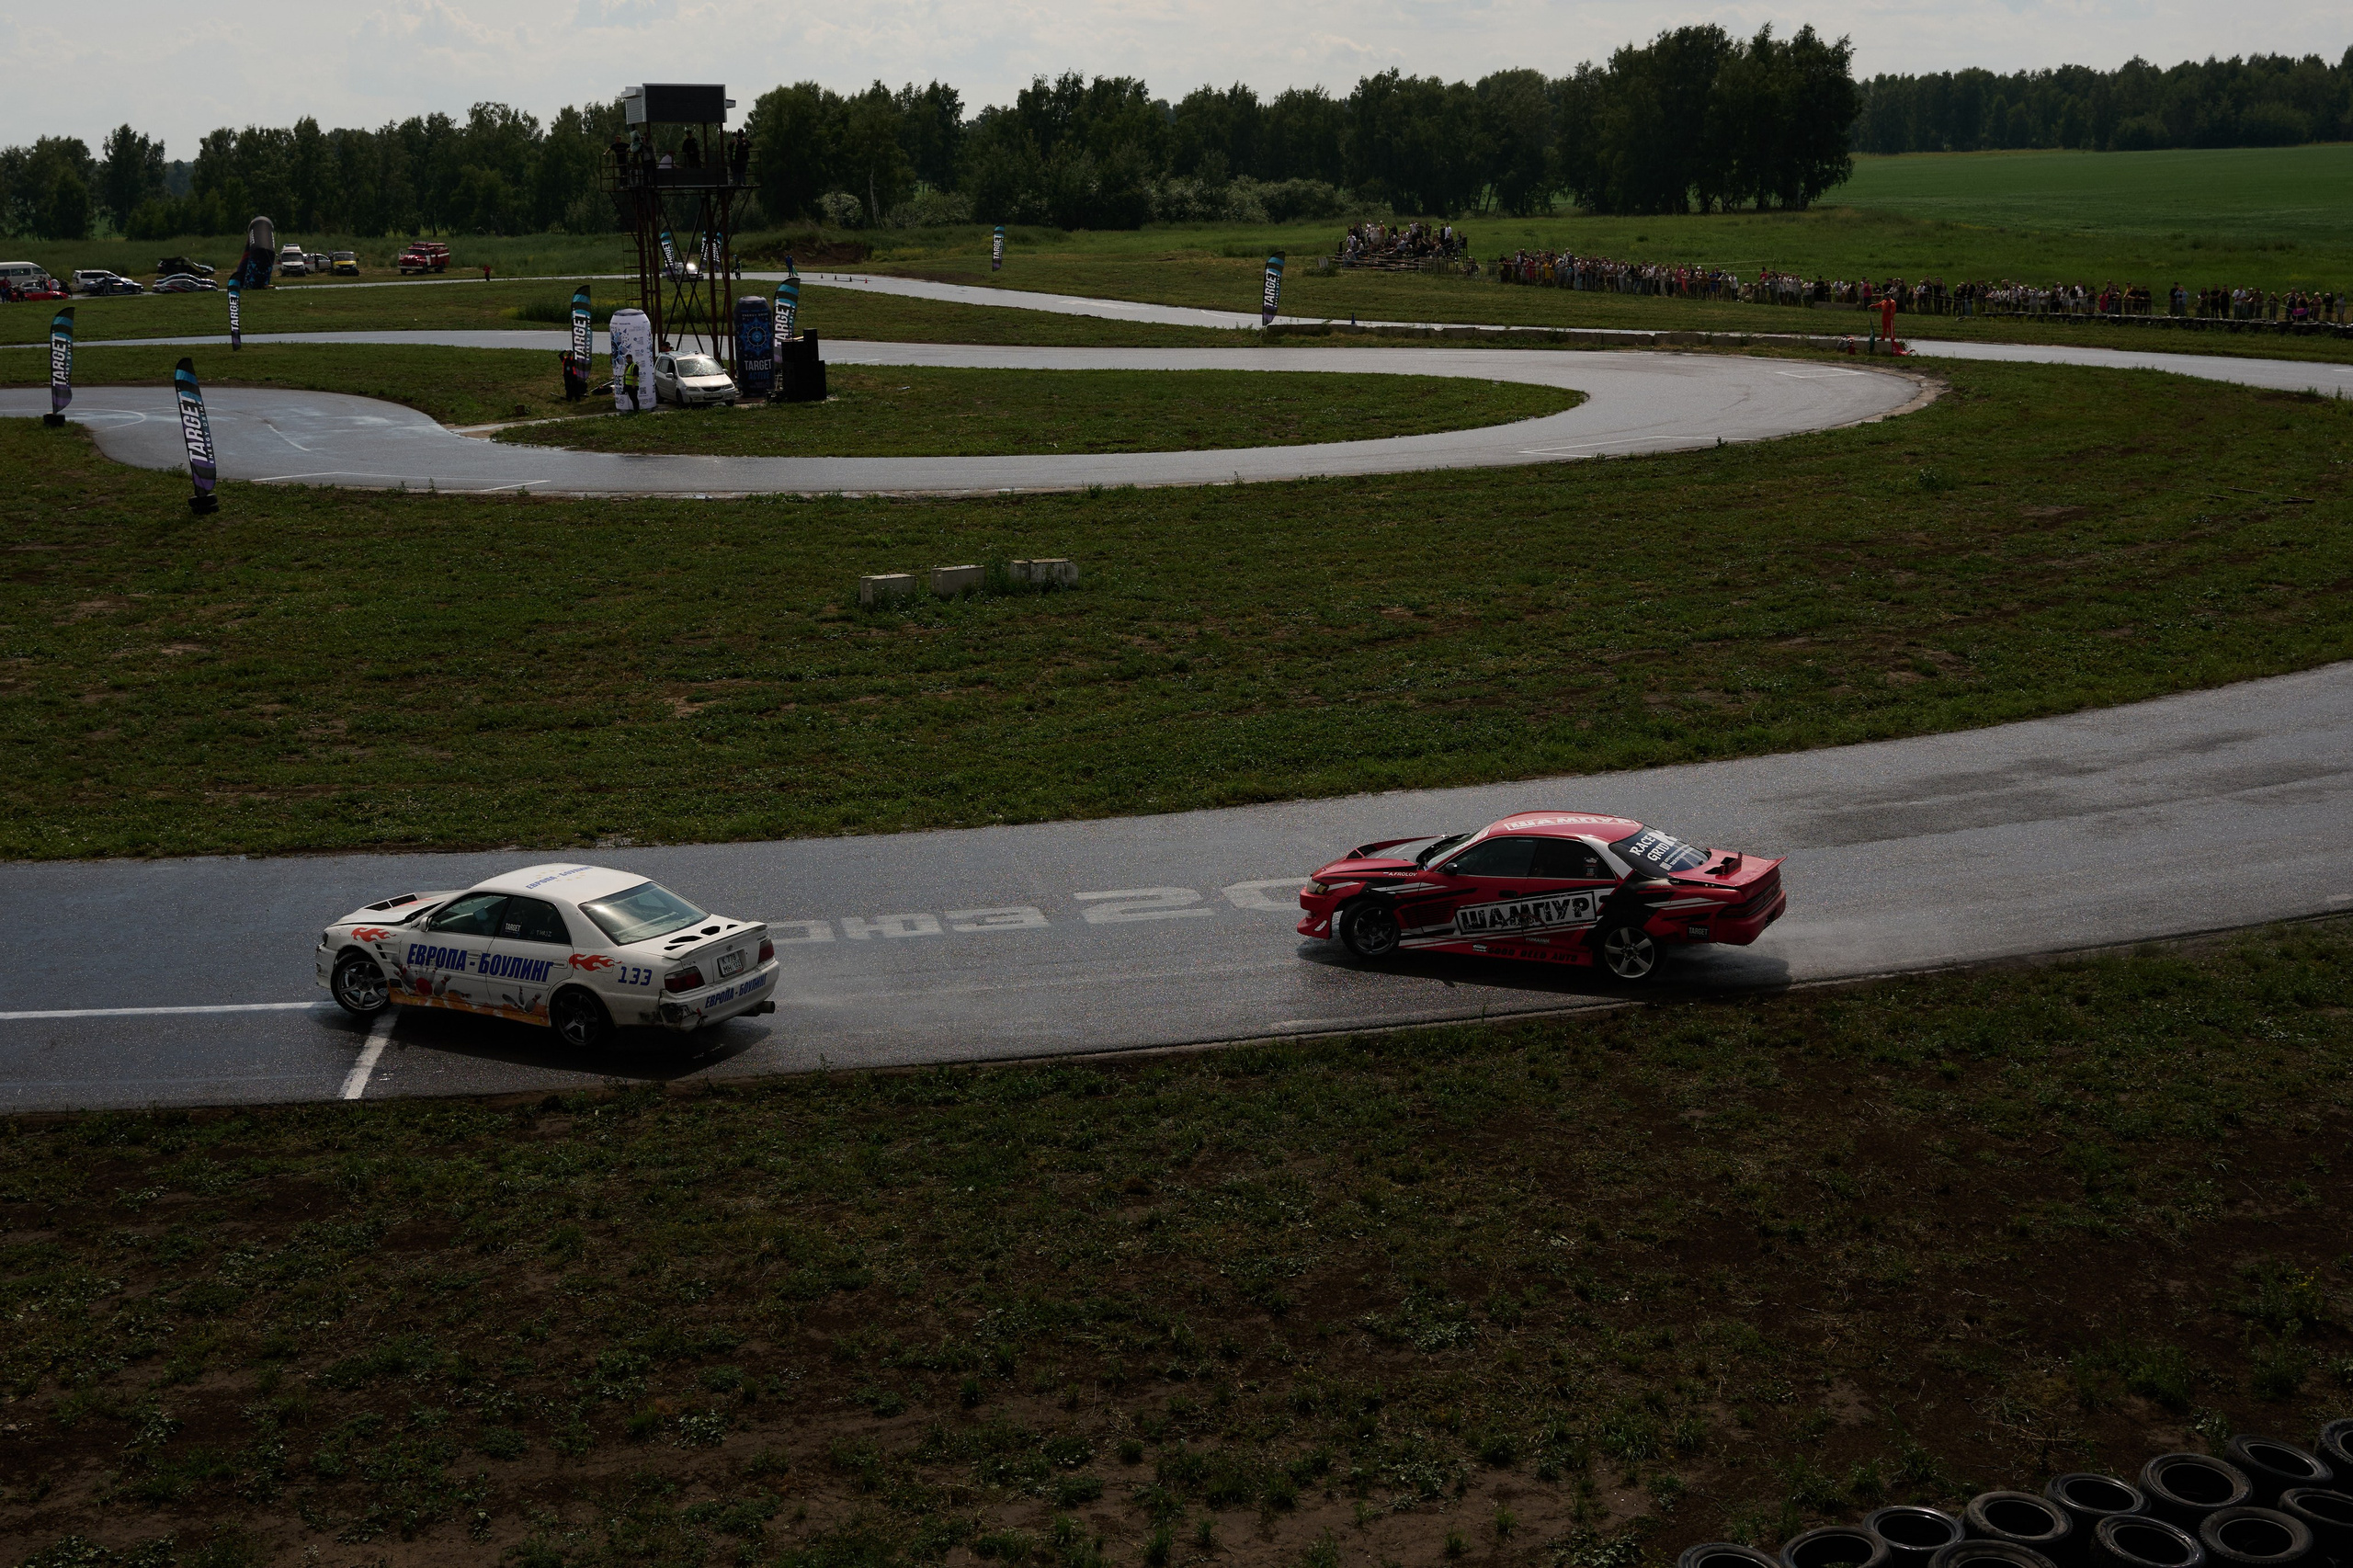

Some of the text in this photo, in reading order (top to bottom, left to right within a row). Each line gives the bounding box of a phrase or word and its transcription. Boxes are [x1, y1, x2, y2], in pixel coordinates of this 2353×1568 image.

[994, 234, 1002, 259] TARGET
[1264, 268, 1277, 307] TARGET
[228, 292, 239, 331] TARGET
[774, 299, 791, 347] TARGET
[572, 310, 585, 360] TARGET
[51, 333, 67, 387] TARGET
[744, 358, 772, 371] TARGET
[748, 370, 770, 381] ACTIVE
[177, 391, 209, 462] TARGET
[197, 400, 214, 464] ENERGY DRINK
[1511, 817, 1631, 829] ШАМПУР
[1629, 835, 1656, 857] RACE
[1646, 842, 1670, 861] GRID
[525, 875, 558, 890] ЕВРОПА
[505, 923, 521, 932] TARGET
[1460, 897, 1590, 930] ШАМПУР
[1688, 926, 1709, 936] TARGET
[406, 943, 467, 971] ЕВРОПА
[478, 953, 554, 983] БОУЛИНГ
[618, 966, 653, 986] 133
[705, 986, 734, 1008] ЕВРОПА
[738, 972, 768, 996] БОУЛИНГ
